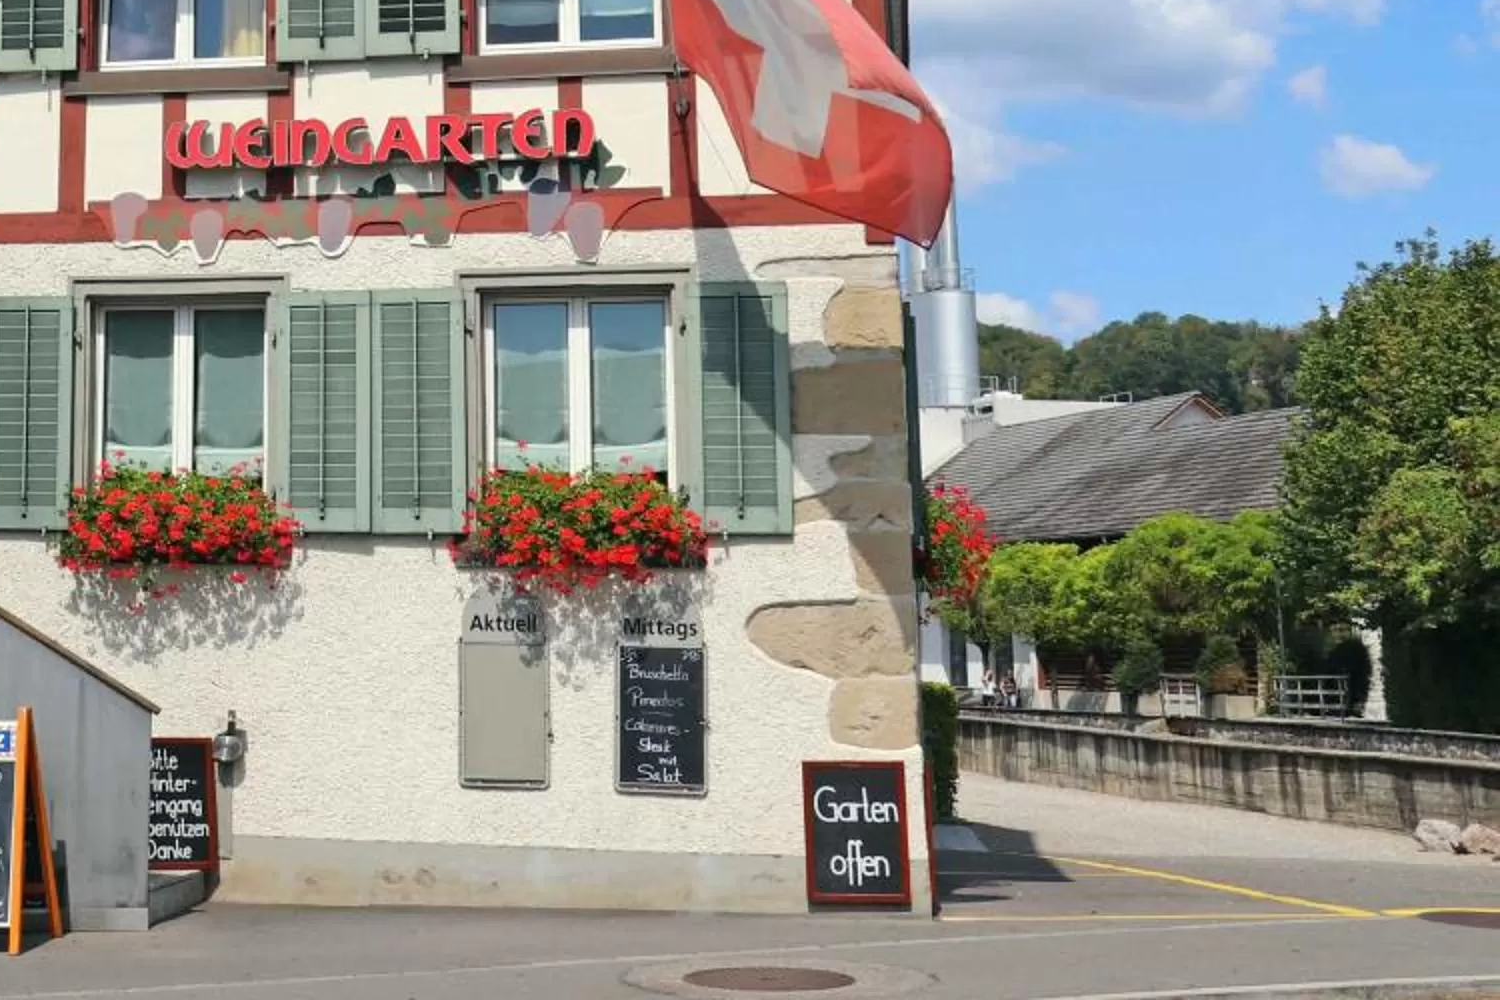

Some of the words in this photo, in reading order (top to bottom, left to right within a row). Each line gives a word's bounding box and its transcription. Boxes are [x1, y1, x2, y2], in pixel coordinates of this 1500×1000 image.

[164, 108, 596, 168] WEINGARTEN
[469, 615, 537, 633] Aktuell
[623, 618, 698, 640] Mittags
[149, 748, 179, 771] itte
[636, 763, 683, 783] Salat
[813, 786, 899, 823] Garten
[830, 839, 891, 887] offen
